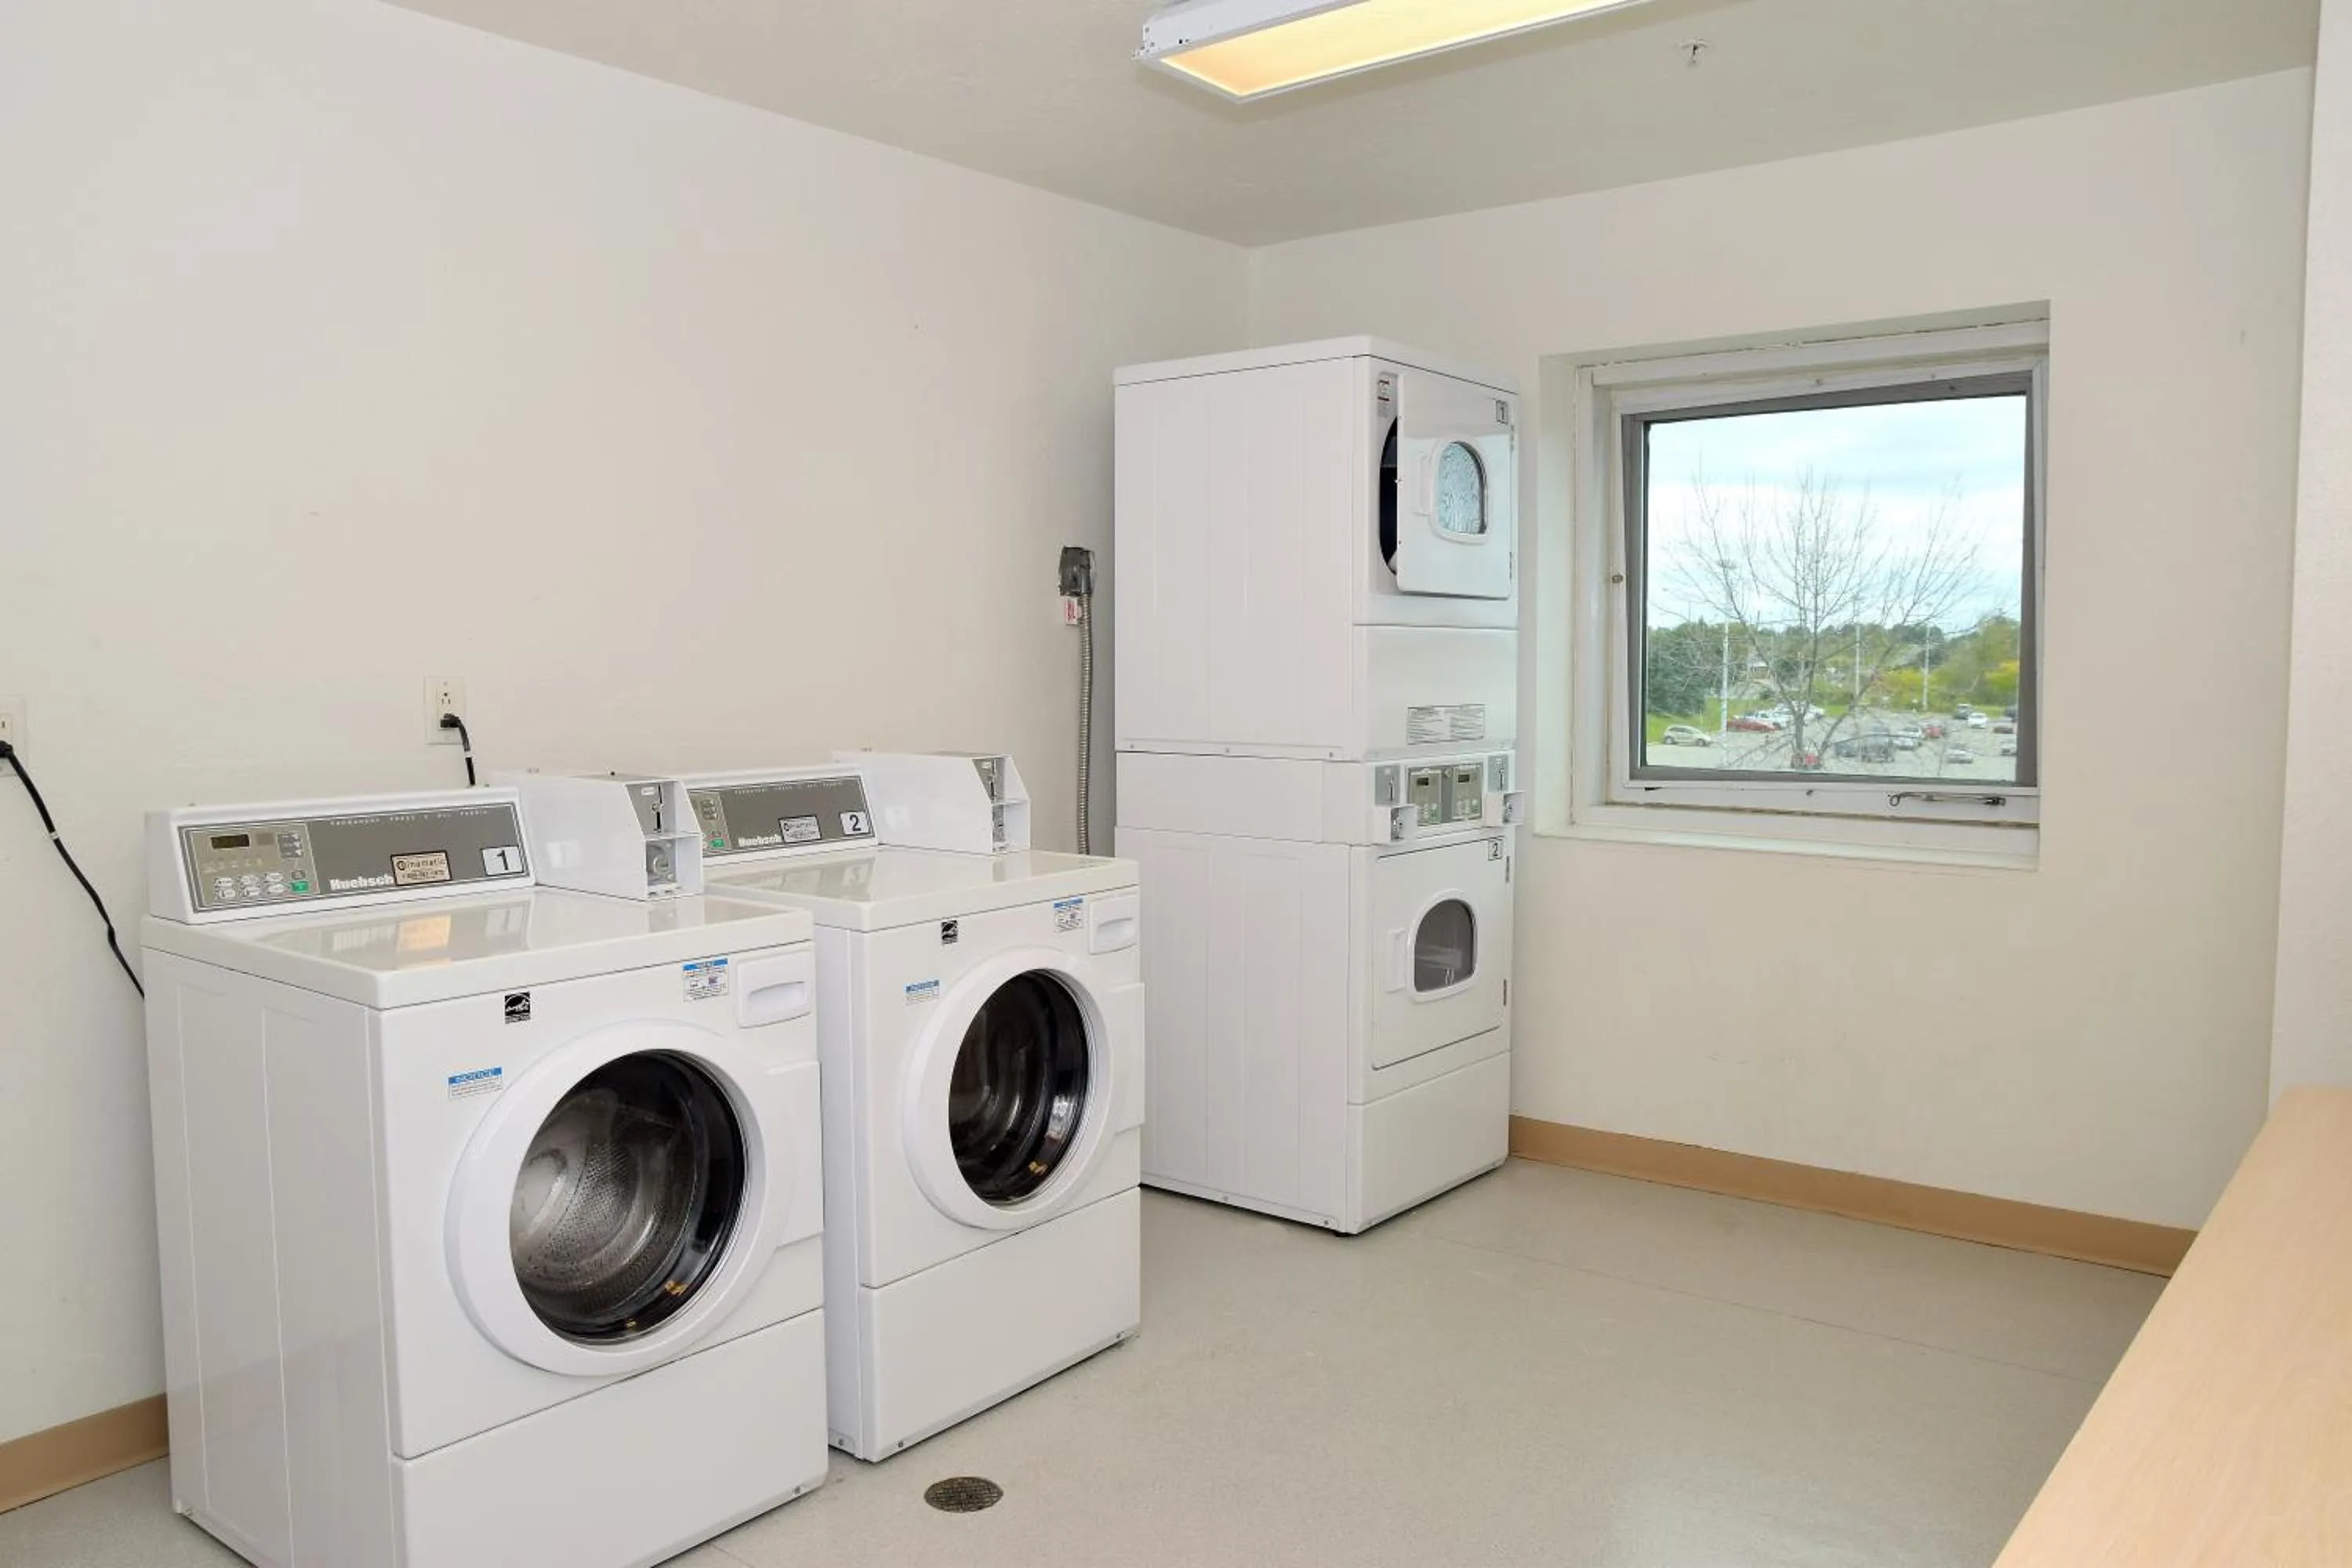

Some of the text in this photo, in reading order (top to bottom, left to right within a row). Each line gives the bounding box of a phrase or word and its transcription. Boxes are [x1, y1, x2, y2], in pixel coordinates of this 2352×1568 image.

[849, 814, 861, 831] 2
[1492, 842, 1498, 857] 2
[496, 849, 509, 870] 1
[329, 873, 394, 891] Huebsch
